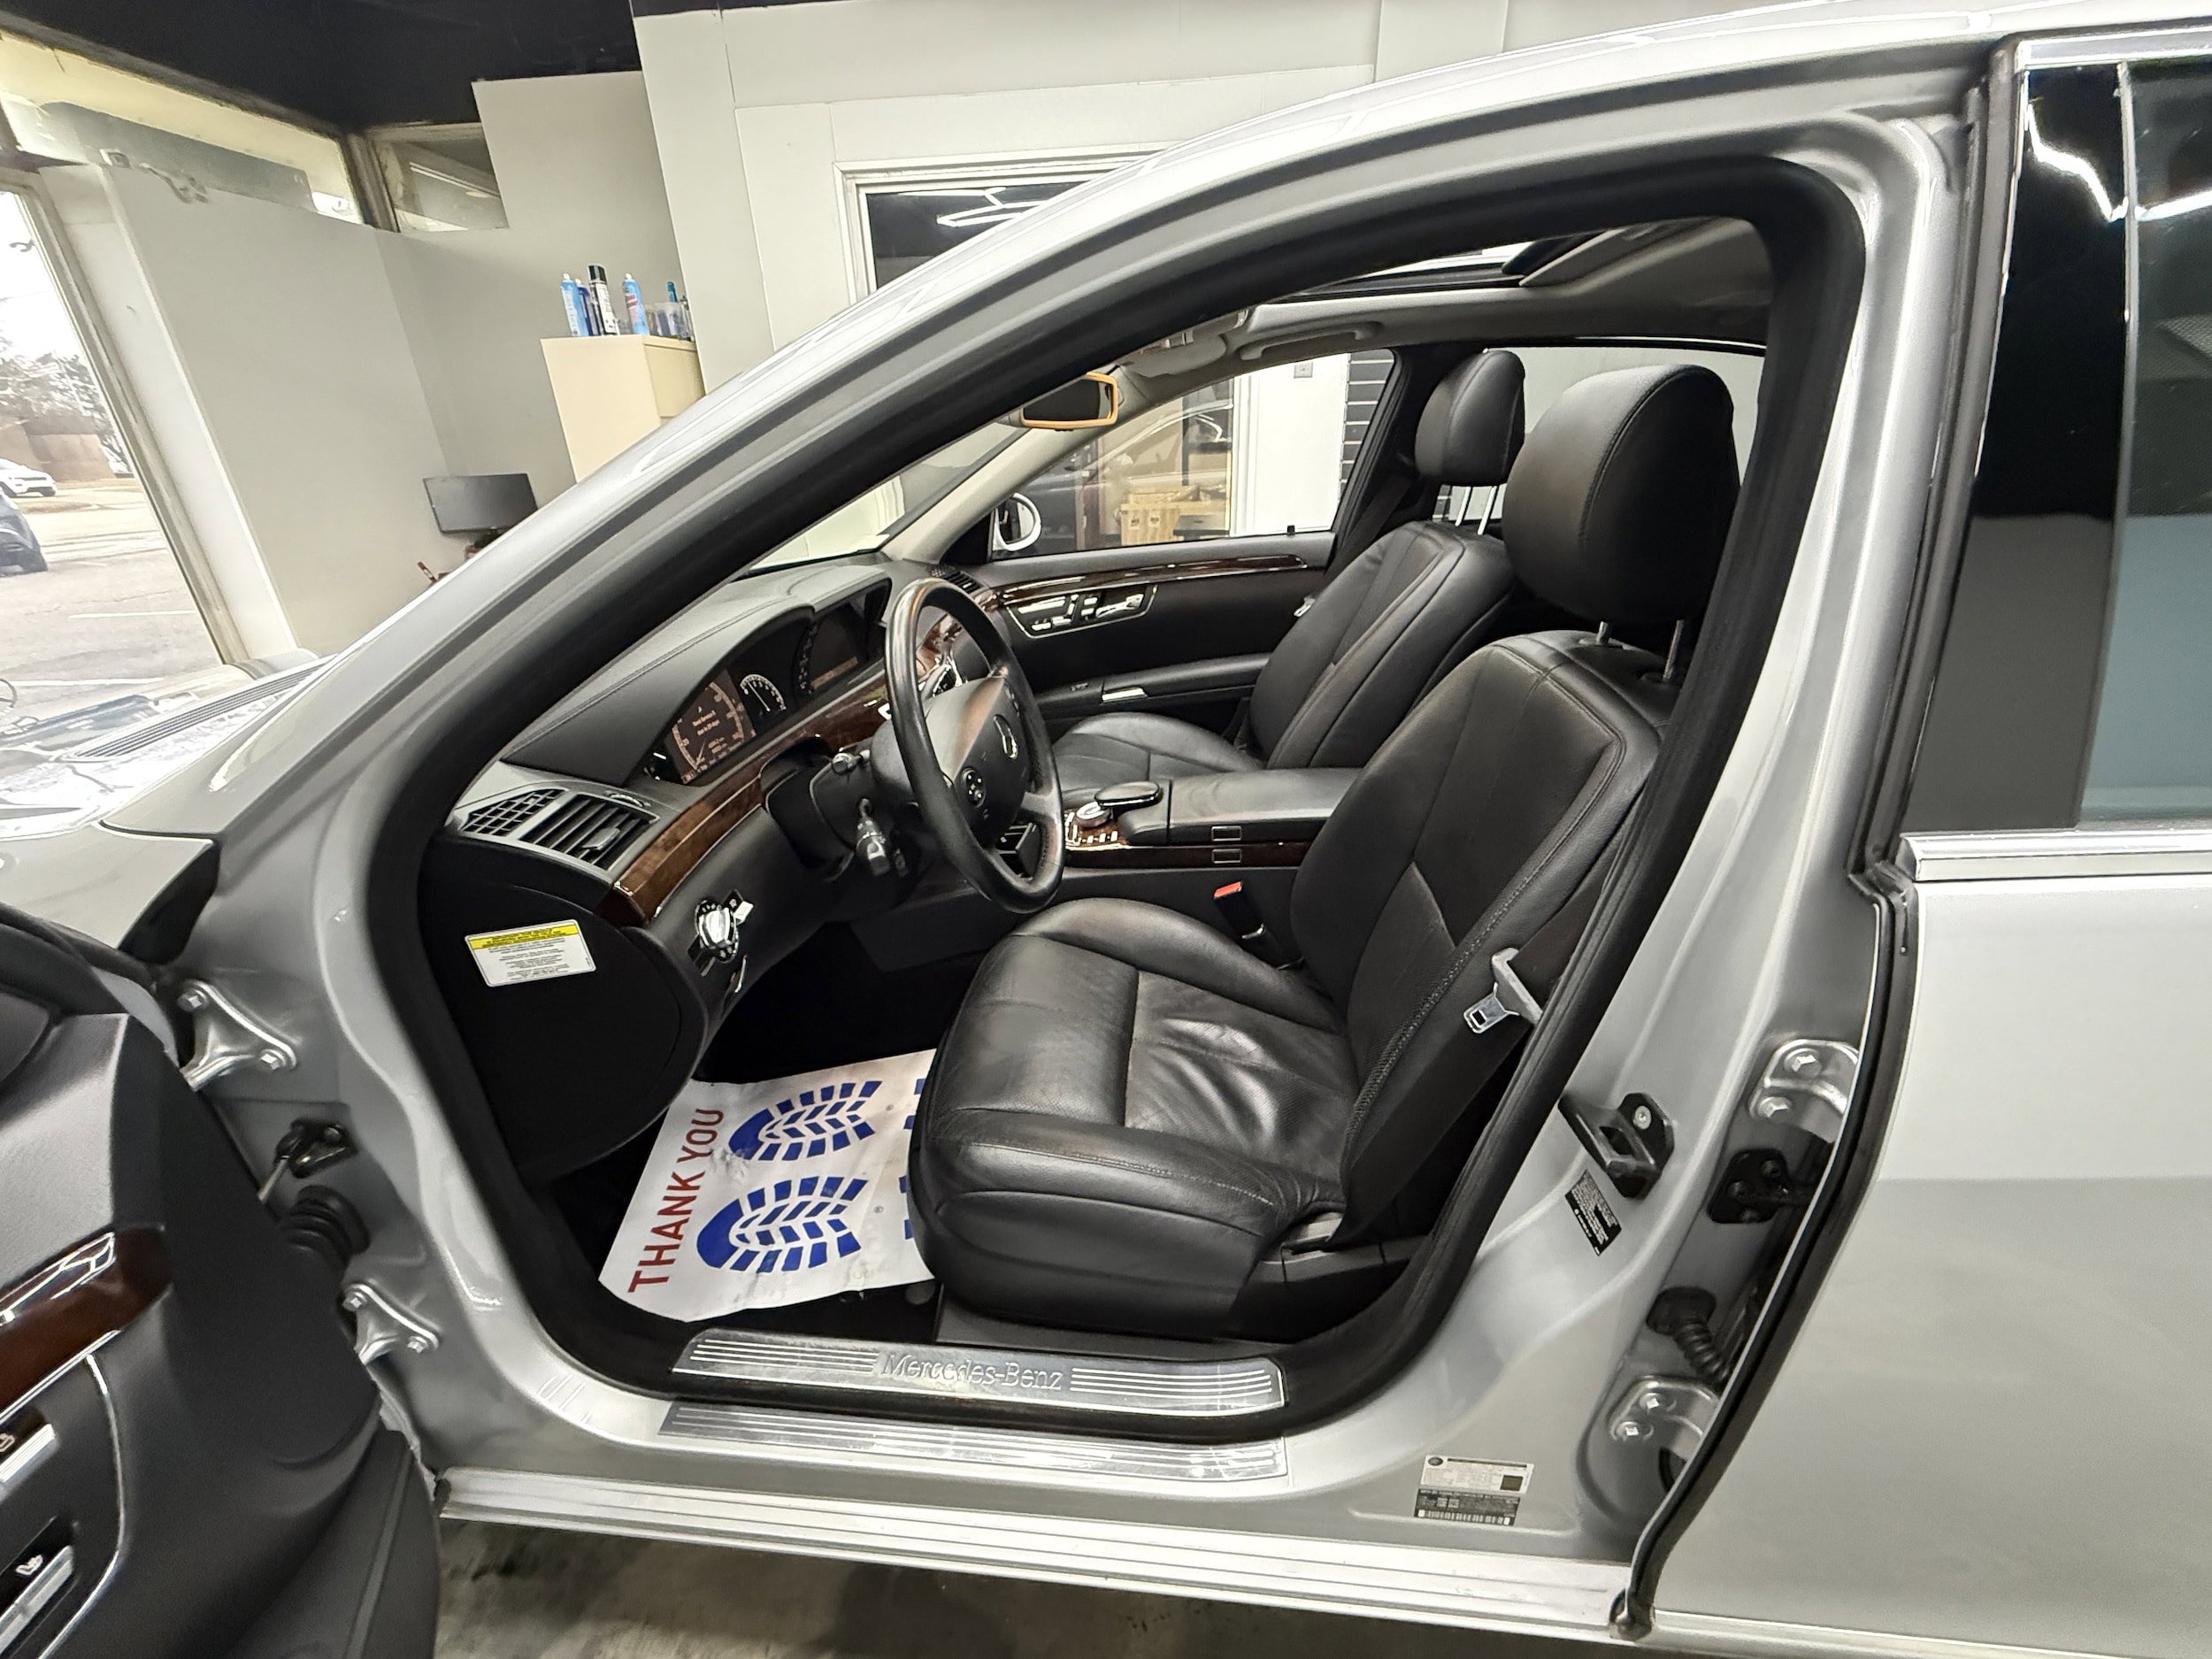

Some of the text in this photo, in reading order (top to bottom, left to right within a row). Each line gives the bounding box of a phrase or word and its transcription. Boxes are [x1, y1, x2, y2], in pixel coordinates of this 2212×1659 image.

[627, 1109, 724, 1293] THANK YOU
[882, 1354, 1064, 1392] Mercedes-Benz
